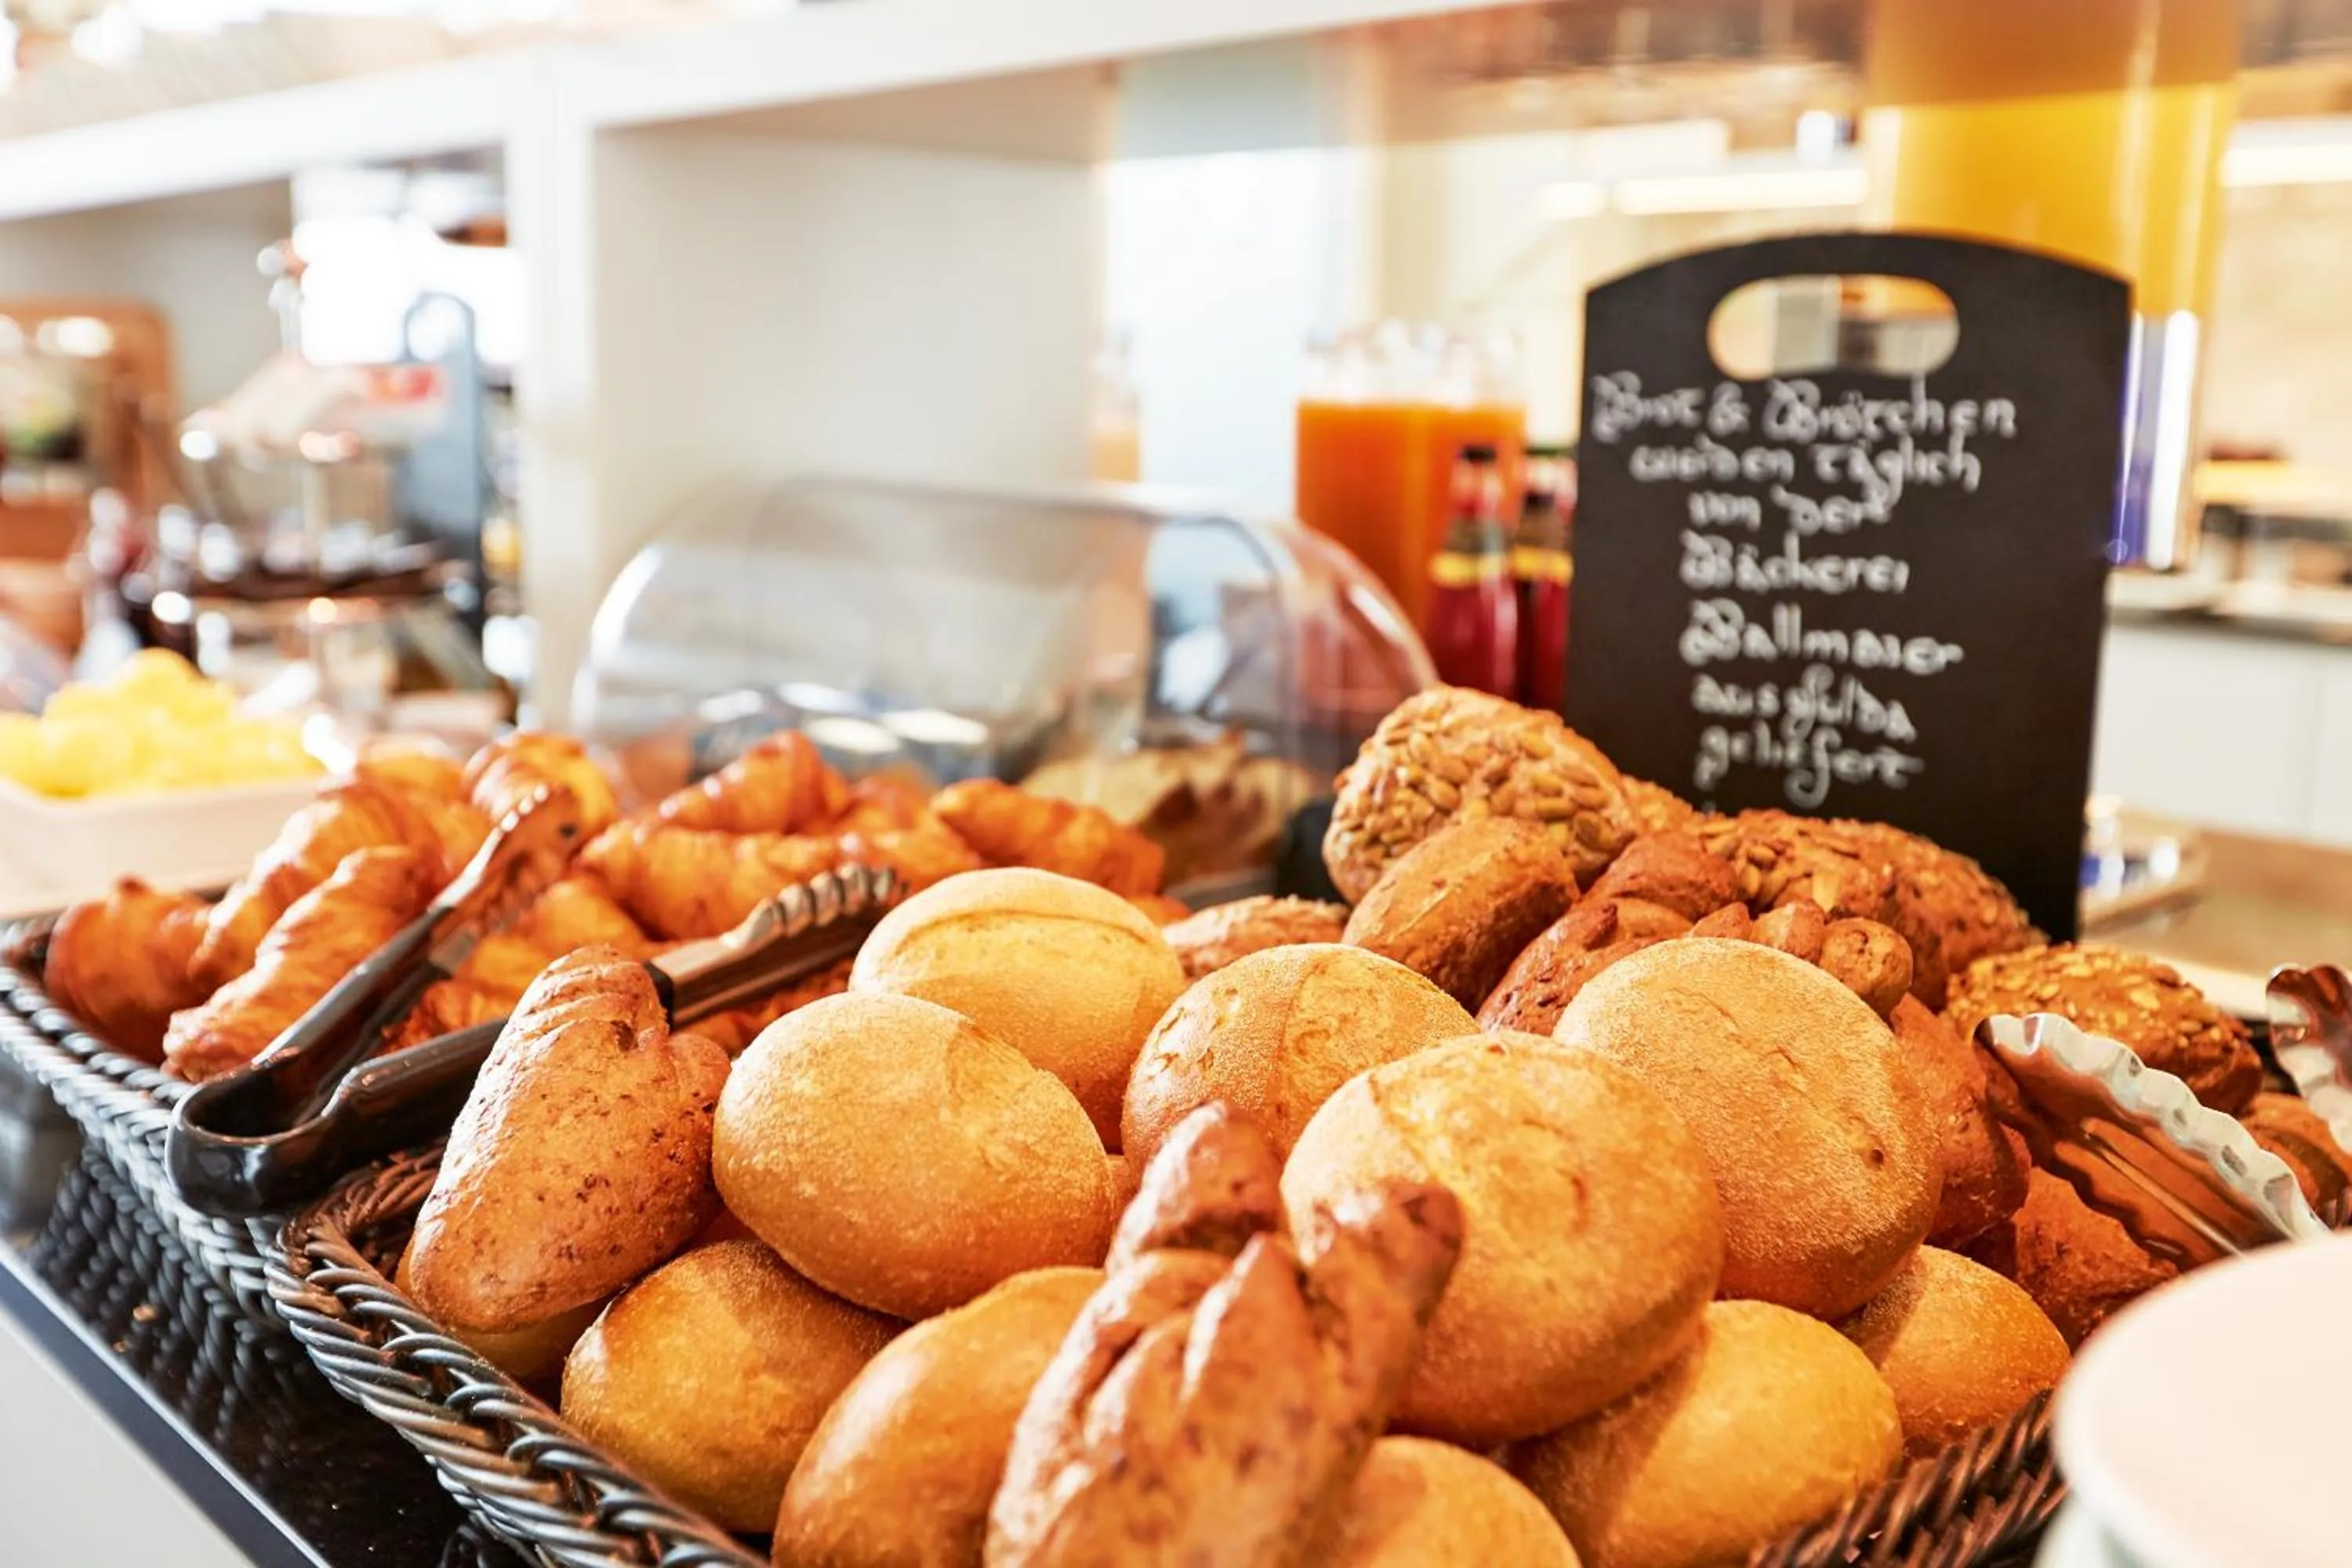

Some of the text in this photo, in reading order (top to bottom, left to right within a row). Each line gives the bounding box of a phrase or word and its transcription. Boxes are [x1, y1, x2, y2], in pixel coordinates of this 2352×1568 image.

[1591, 371, 2017, 444] Brot & Brötchen
[1680, 528, 1910, 594] Bäckerei
